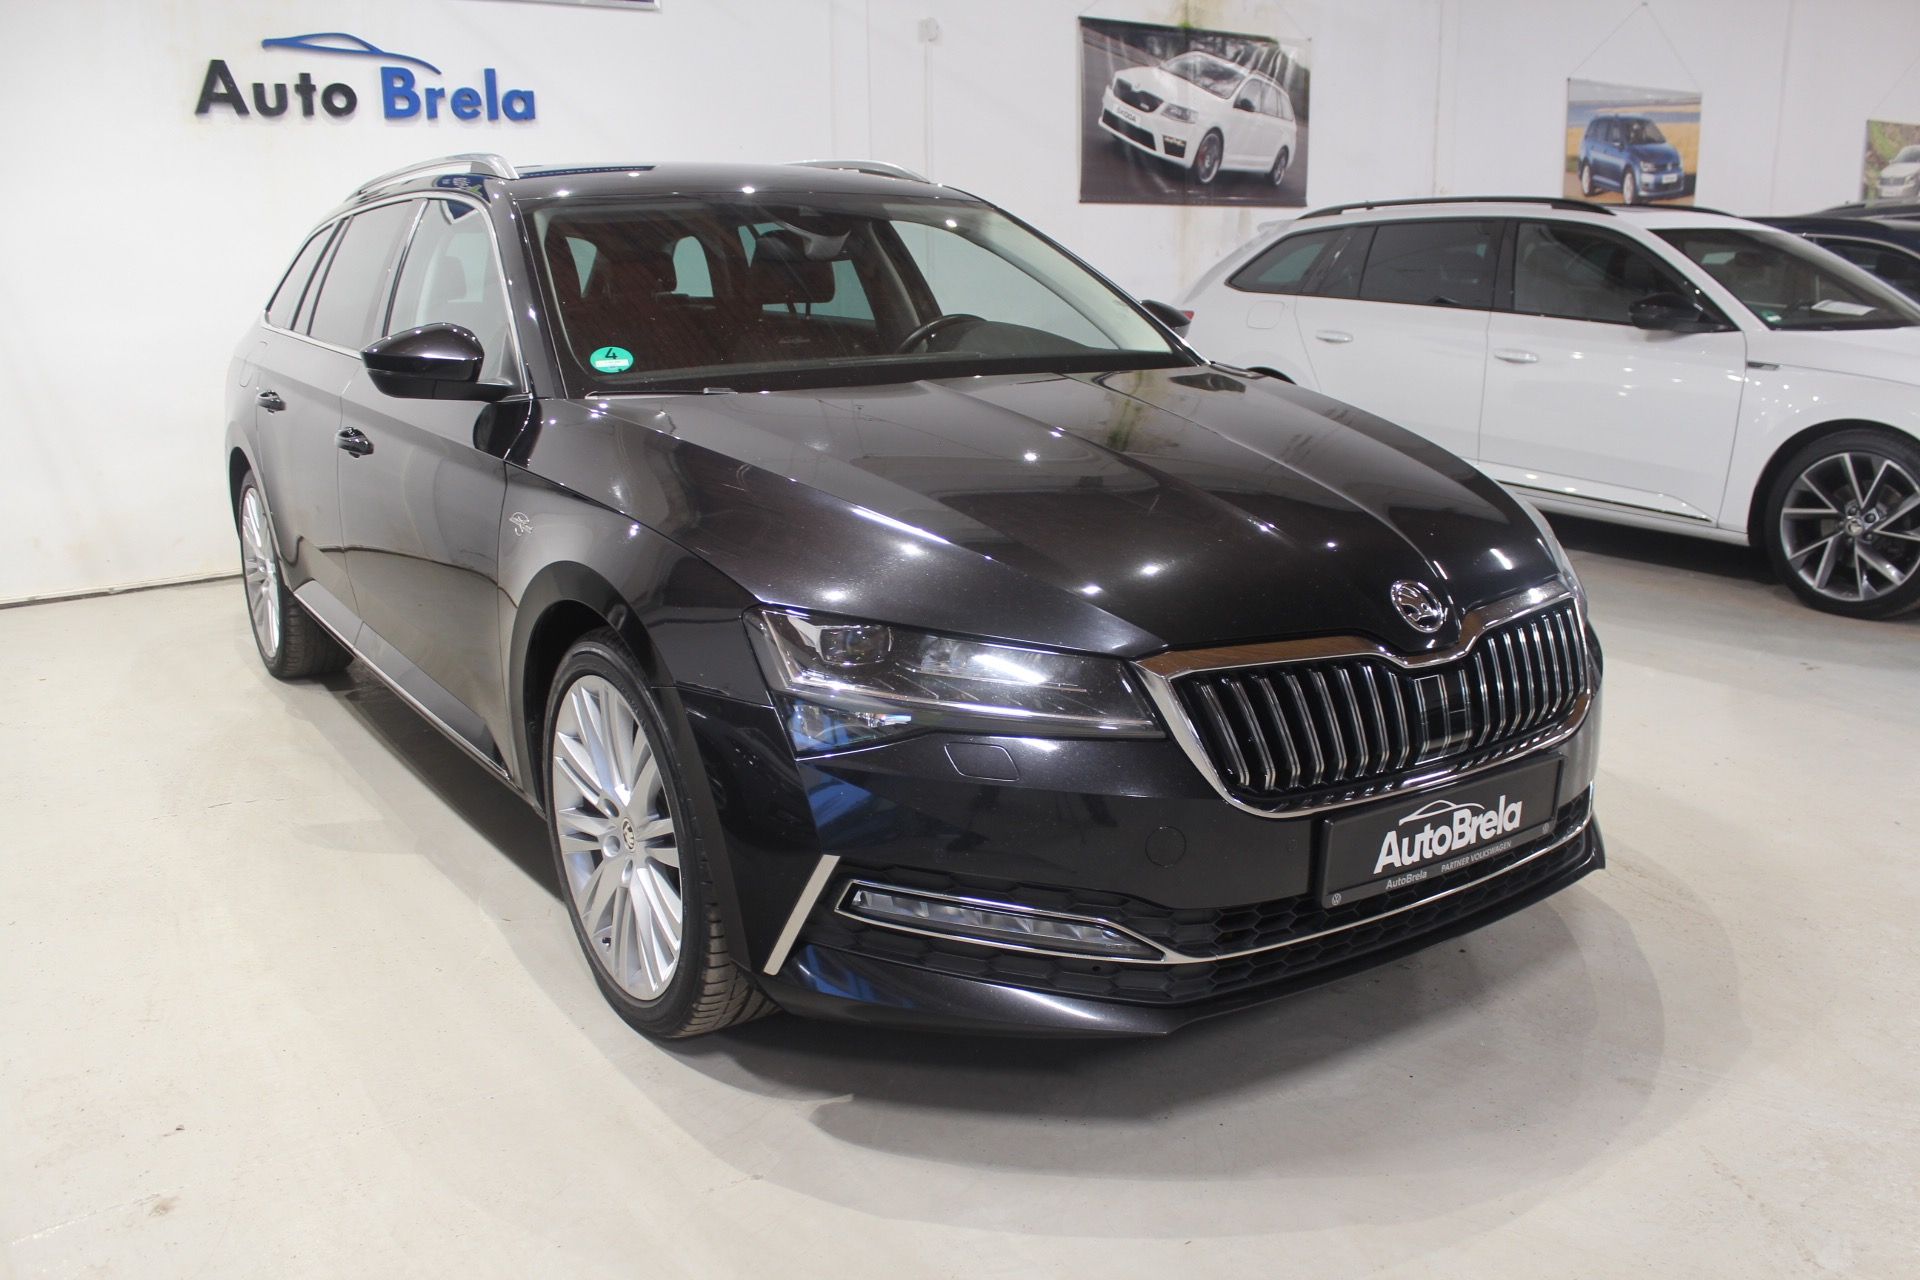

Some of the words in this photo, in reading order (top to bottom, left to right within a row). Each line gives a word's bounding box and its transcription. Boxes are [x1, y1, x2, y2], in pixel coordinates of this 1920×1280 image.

[195, 59, 358, 117] Auto
[380, 66, 536, 122] Brela
[605, 348, 618, 360] 4
[1373, 795, 1523, 875] AutoBrela
[1441, 856, 1470, 873] PARTNER
[1470, 840, 1512, 863] VOLKSWAGEN
[1385, 869, 1428, 890] AutoBrela
